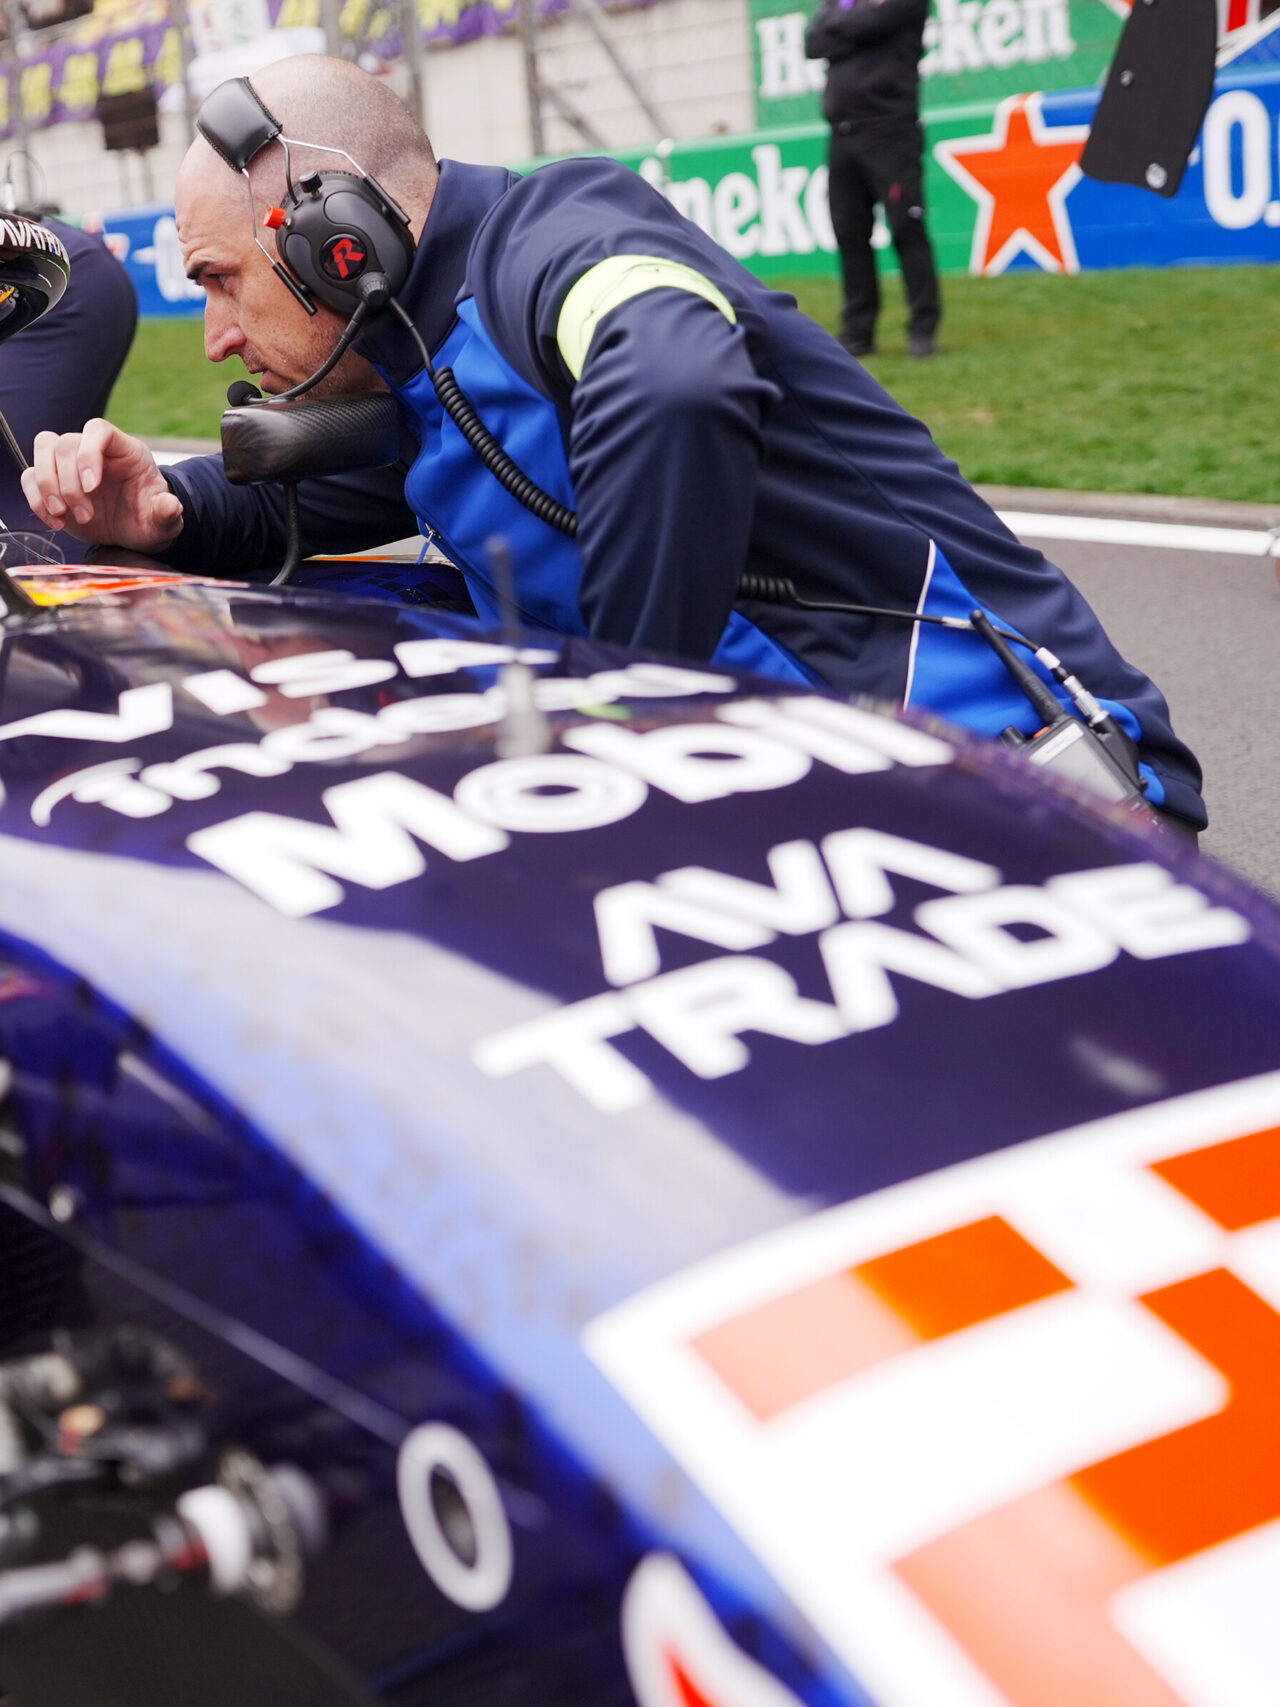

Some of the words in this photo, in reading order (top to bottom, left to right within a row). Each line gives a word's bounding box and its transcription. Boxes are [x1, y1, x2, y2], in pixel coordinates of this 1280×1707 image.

[186, 695, 956, 919] Mobil
[592, 827, 1003, 987] AVA
[471, 861, 1251, 1115] TRADE
